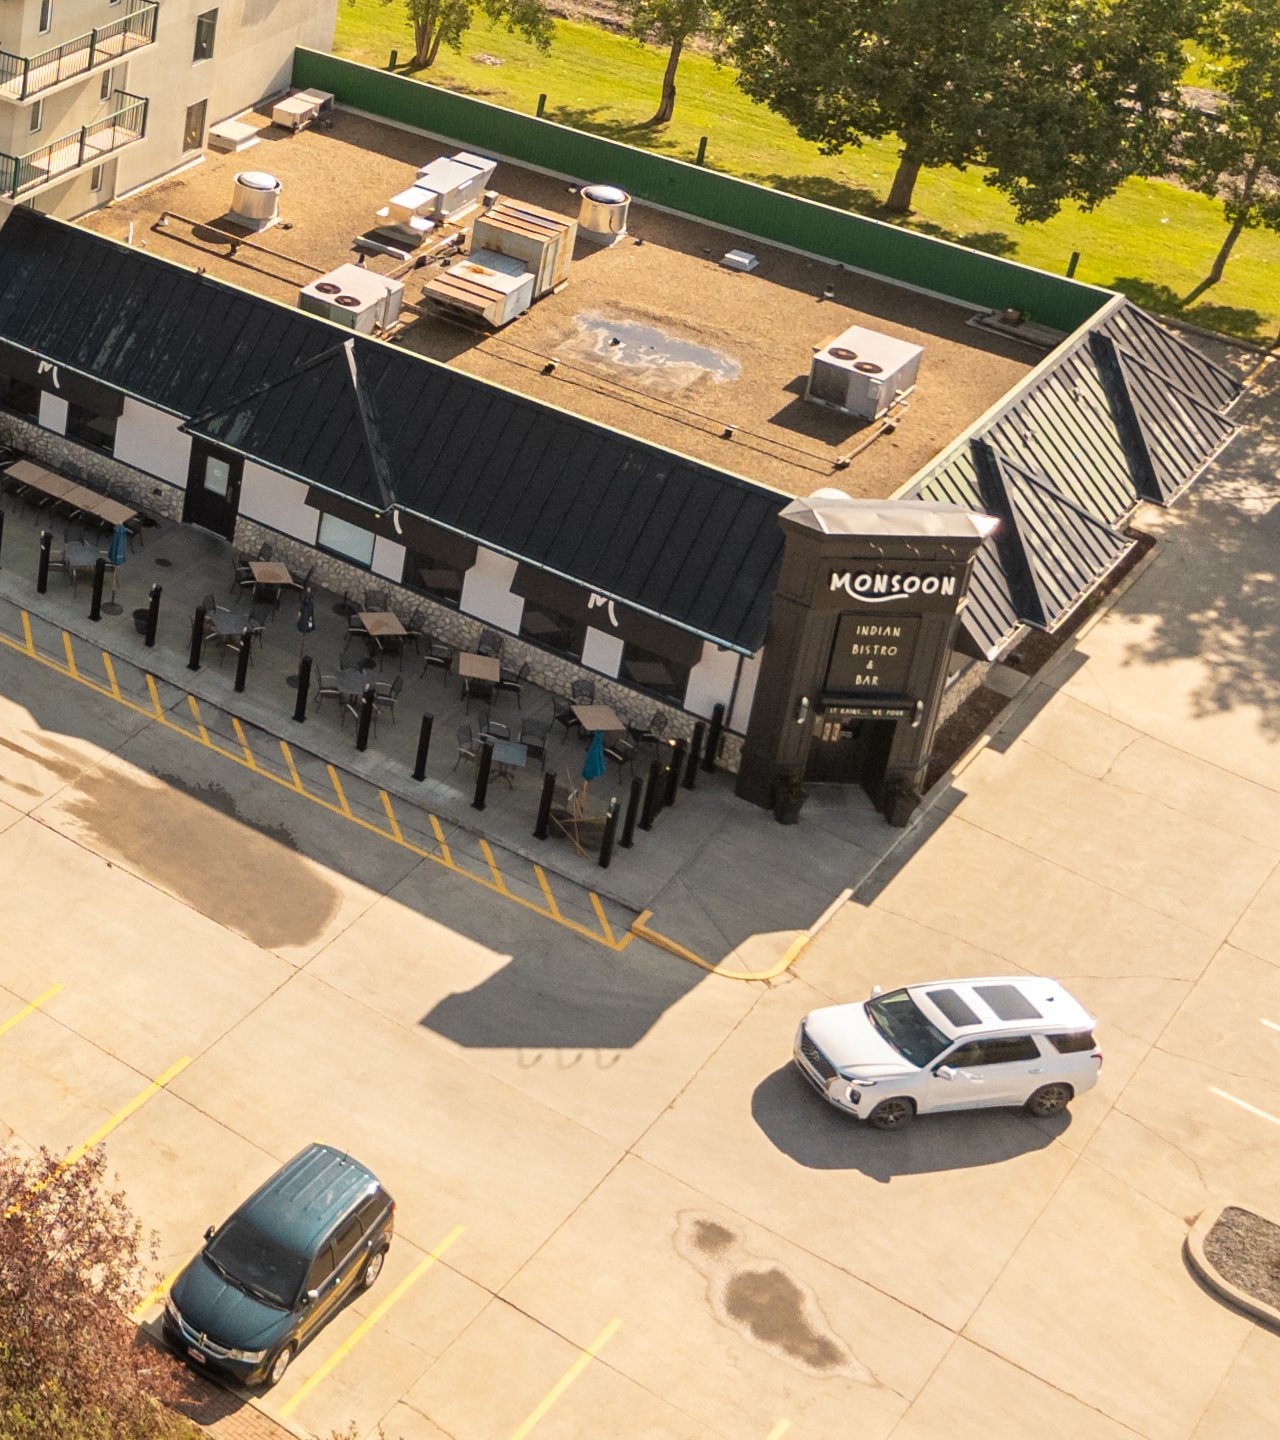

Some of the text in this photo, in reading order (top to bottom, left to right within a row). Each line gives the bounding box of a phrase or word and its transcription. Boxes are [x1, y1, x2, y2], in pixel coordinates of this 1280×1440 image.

[830, 572, 956, 603] MONSOON
[856, 625, 902, 637] INDIAN
[851, 644, 899, 656] BISTRO
[865, 660, 874, 670] &
[855, 674, 880, 686] BAR
